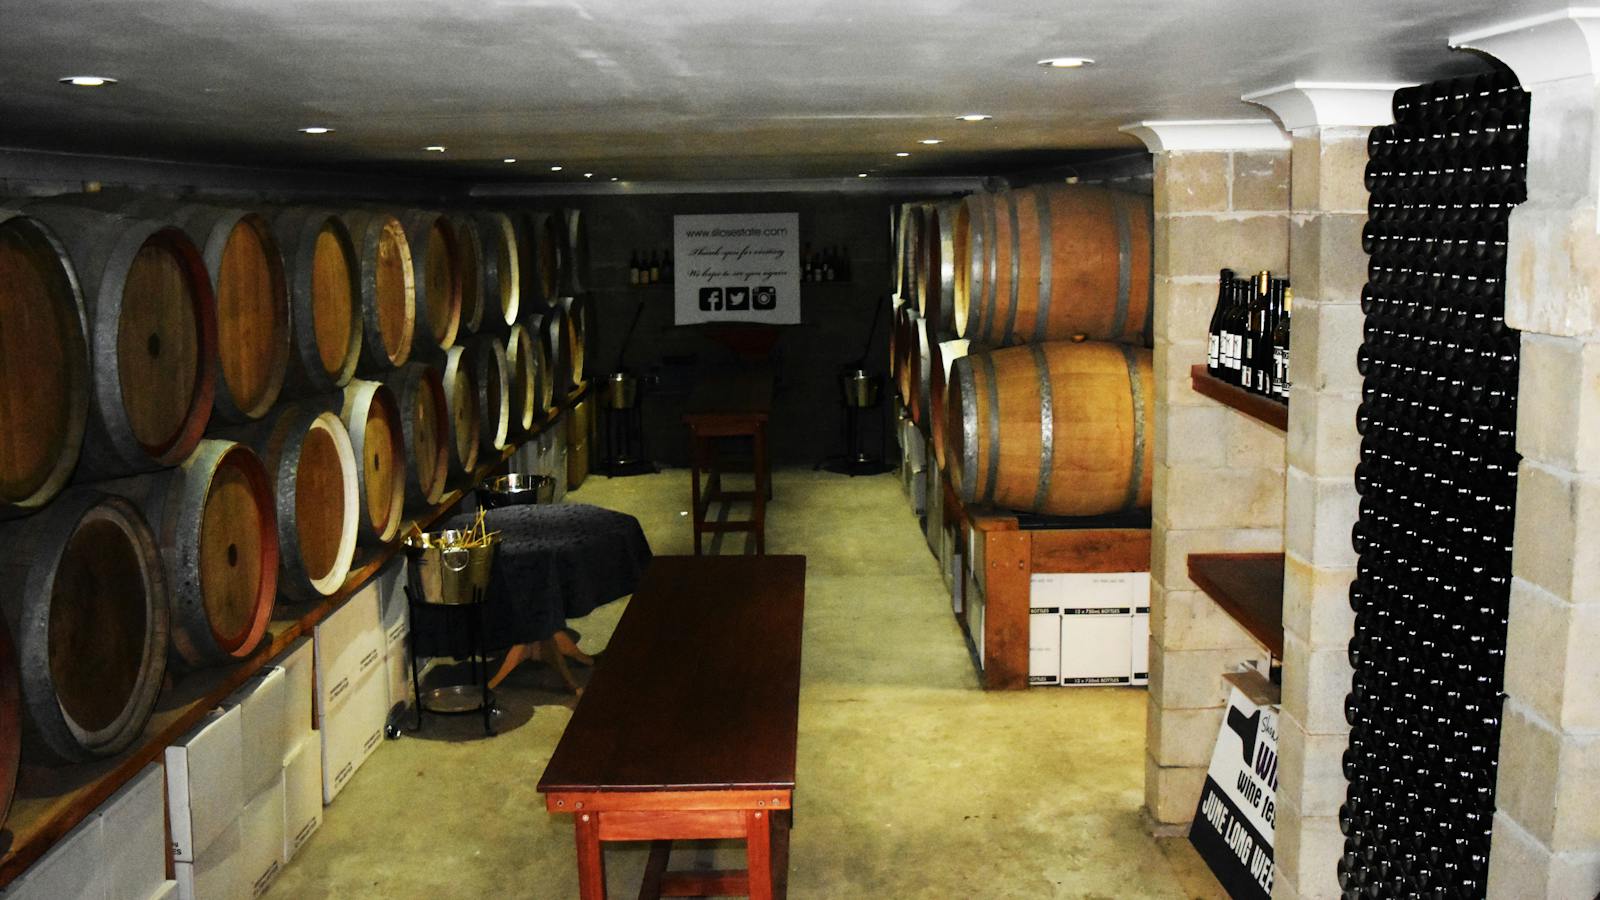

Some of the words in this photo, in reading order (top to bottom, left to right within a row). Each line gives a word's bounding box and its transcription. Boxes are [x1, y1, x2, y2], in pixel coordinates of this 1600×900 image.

[688, 246, 723, 256] Thank
[721, 251, 738, 261] you
[737, 245, 752, 260] for
[753, 248, 785, 260] visiting
[688, 269, 700, 277] We
[701, 267, 721, 282] hope
[744, 271, 761, 281] you
[762, 271, 787, 281] again
[1237, 770, 1262, 808] wine
[1202, 790, 1229, 835] JUNE
[1224, 815, 1253, 866] LONG
